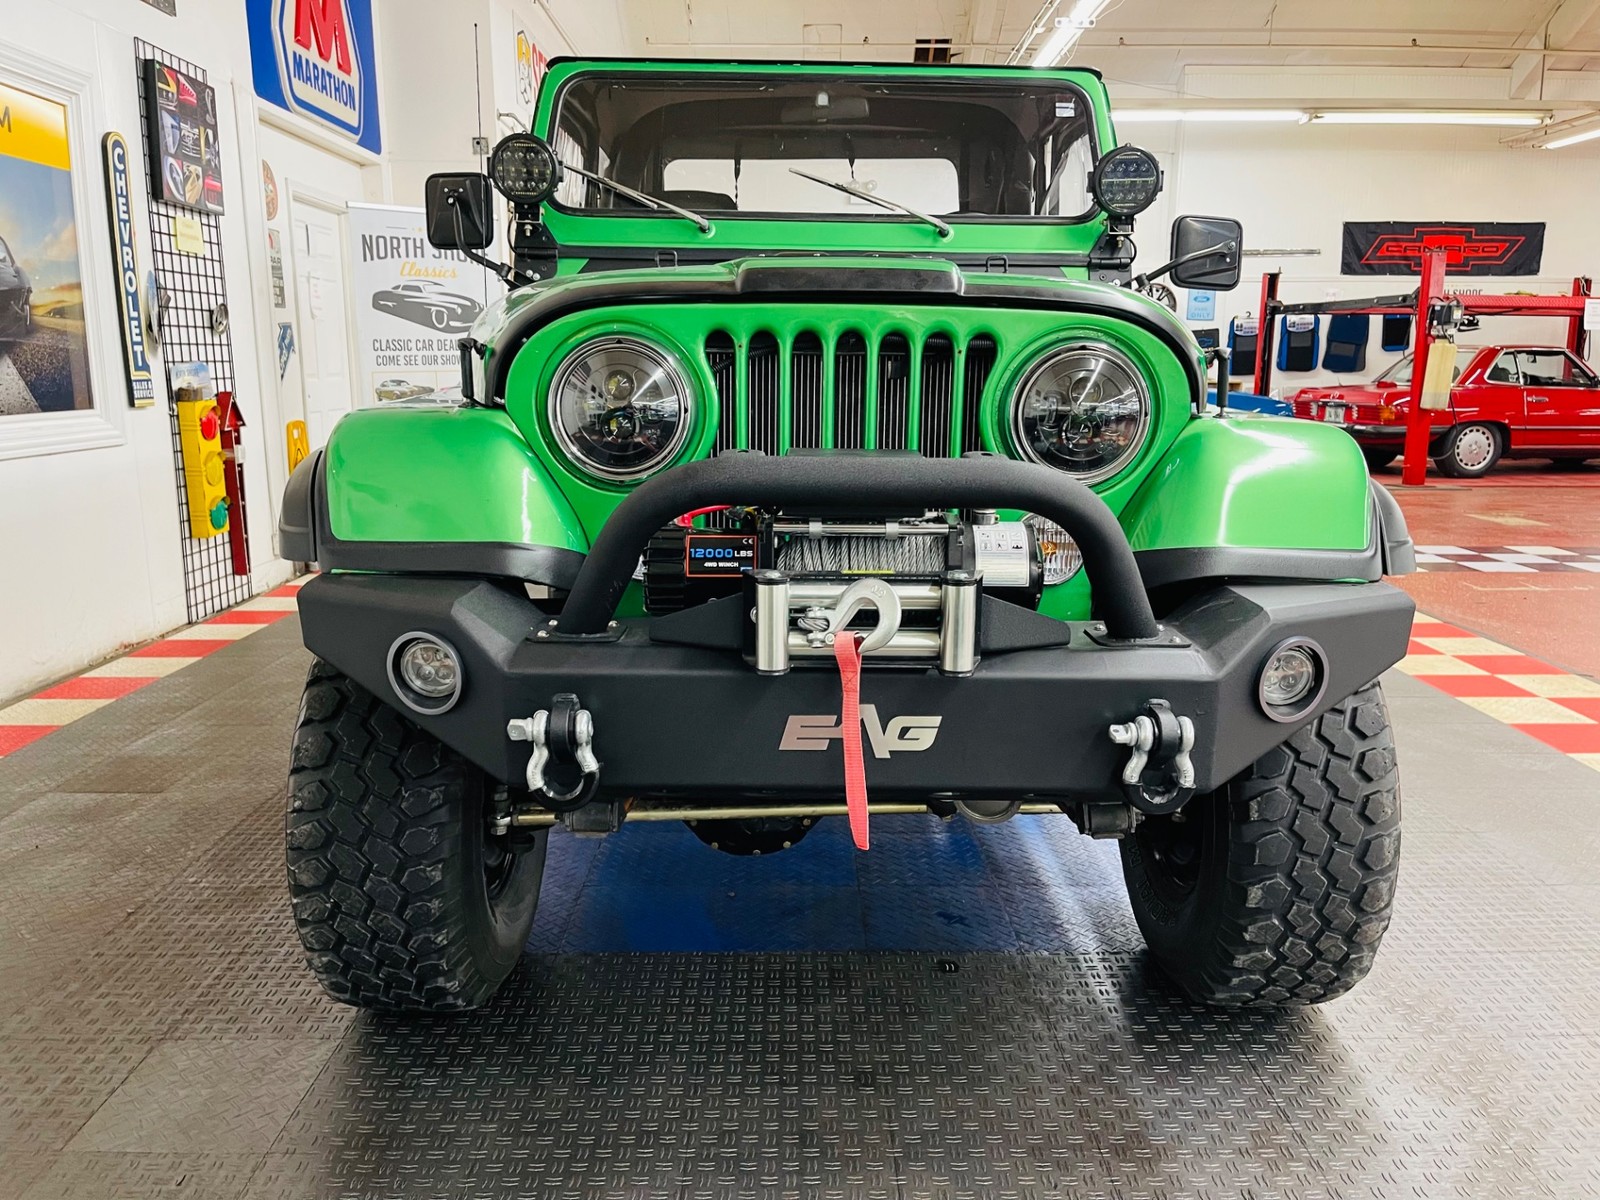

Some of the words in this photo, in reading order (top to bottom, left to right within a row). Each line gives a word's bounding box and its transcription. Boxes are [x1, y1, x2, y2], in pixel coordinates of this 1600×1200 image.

[293, 50, 356, 111] MARATHON
[113, 147, 144, 367] CHEVROLET
[361, 233, 425, 263] NORTH
[399, 261, 458, 279] Classics
[372, 338, 412, 352] CLASSIC
[415, 338, 434, 352] CAR
[375, 354, 401, 366] COME
[404, 354, 418, 366] SEE
[421, 354, 439, 366] OUR
[690, 548, 733, 558] 12000
